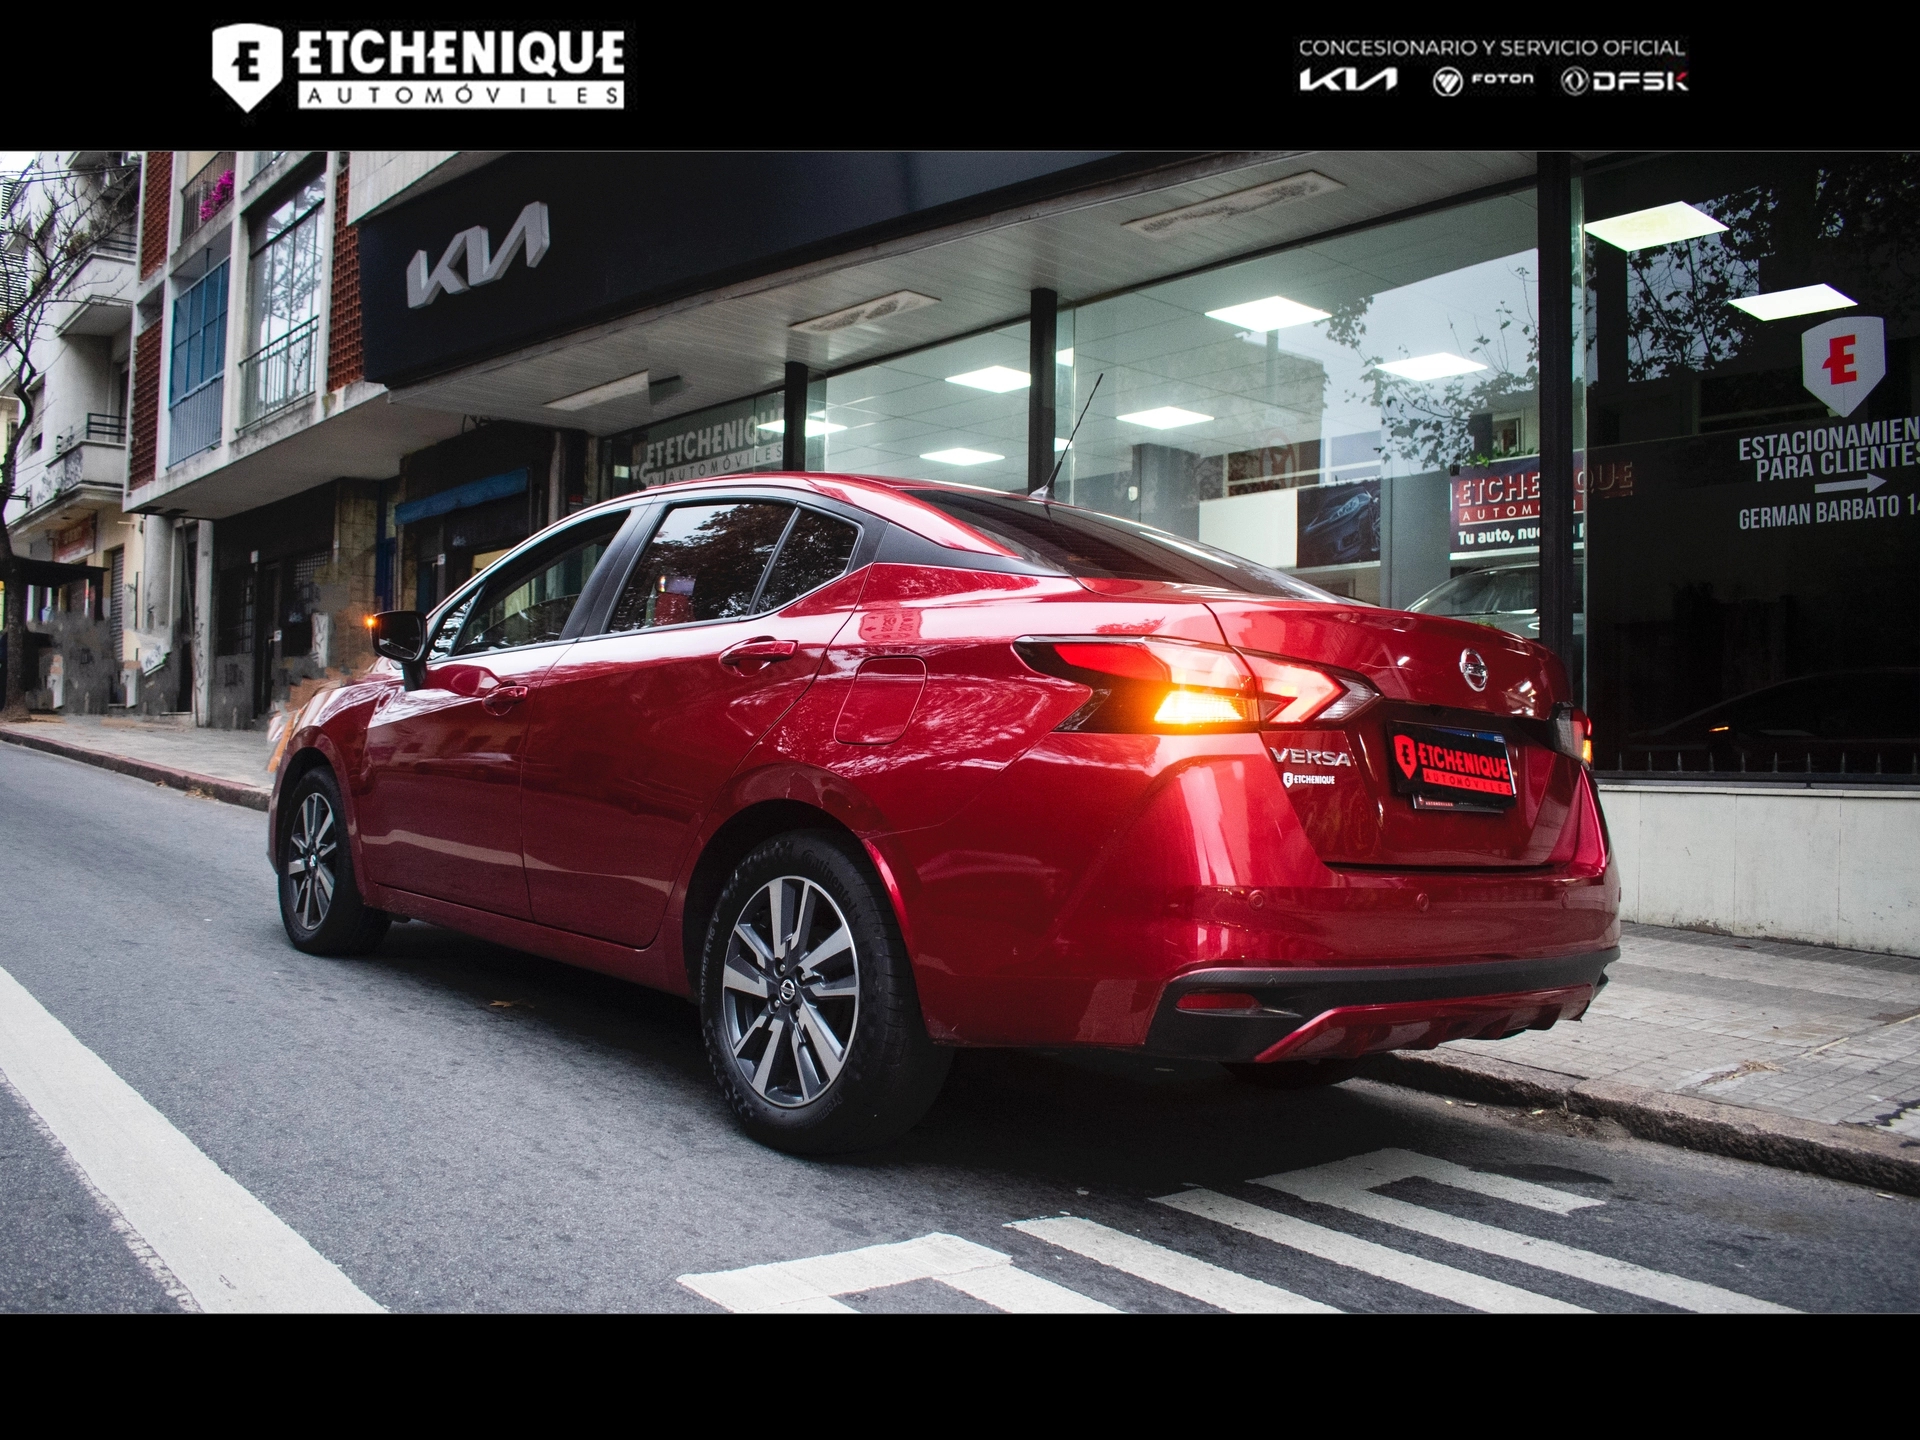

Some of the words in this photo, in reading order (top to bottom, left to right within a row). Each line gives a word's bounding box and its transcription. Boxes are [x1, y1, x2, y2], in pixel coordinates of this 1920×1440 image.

[1757, 454, 1814, 482] PARA
[1739, 503, 1811, 530] GERMAN
[1816, 495, 1900, 523] BARBATO
[1907, 493, 1920, 515] 1
[1459, 530, 1475, 545] Tu
[1478, 526, 1515, 544] auto,
[1270, 747, 1352, 767] VERSA
[1418, 742, 1511, 780] ETCHENIQUE
[1294, 774, 1336, 785] ETCHENIQUE
